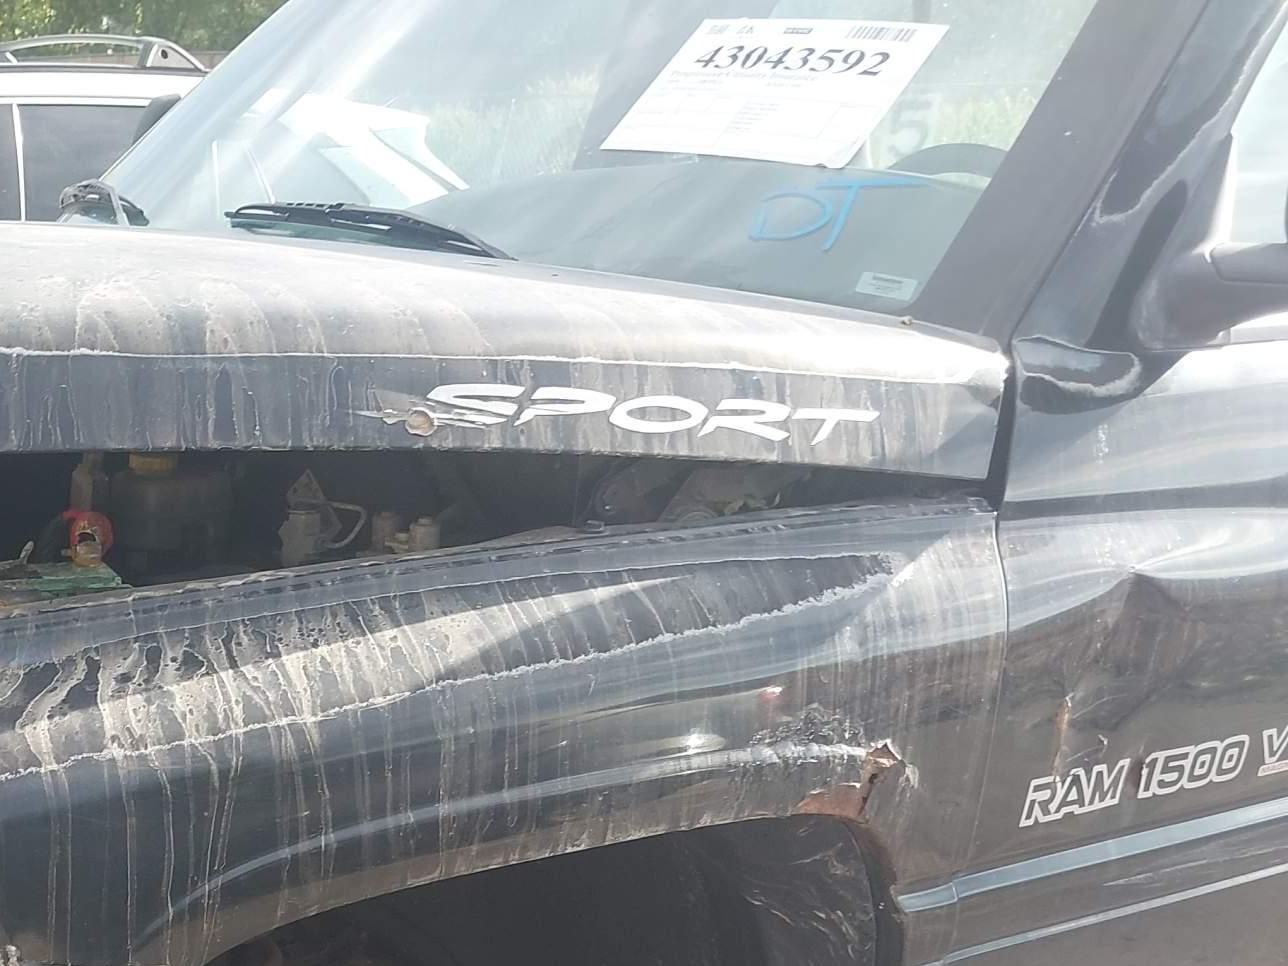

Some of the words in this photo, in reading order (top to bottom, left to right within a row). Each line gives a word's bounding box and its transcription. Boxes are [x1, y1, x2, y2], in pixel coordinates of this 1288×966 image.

[695, 45, 891, 76] 43043592
[410, 383, 881, 446] SPORT
[1019, 758, 1131, 828] RAM
[1137, 734, 1250, 800] 1500
